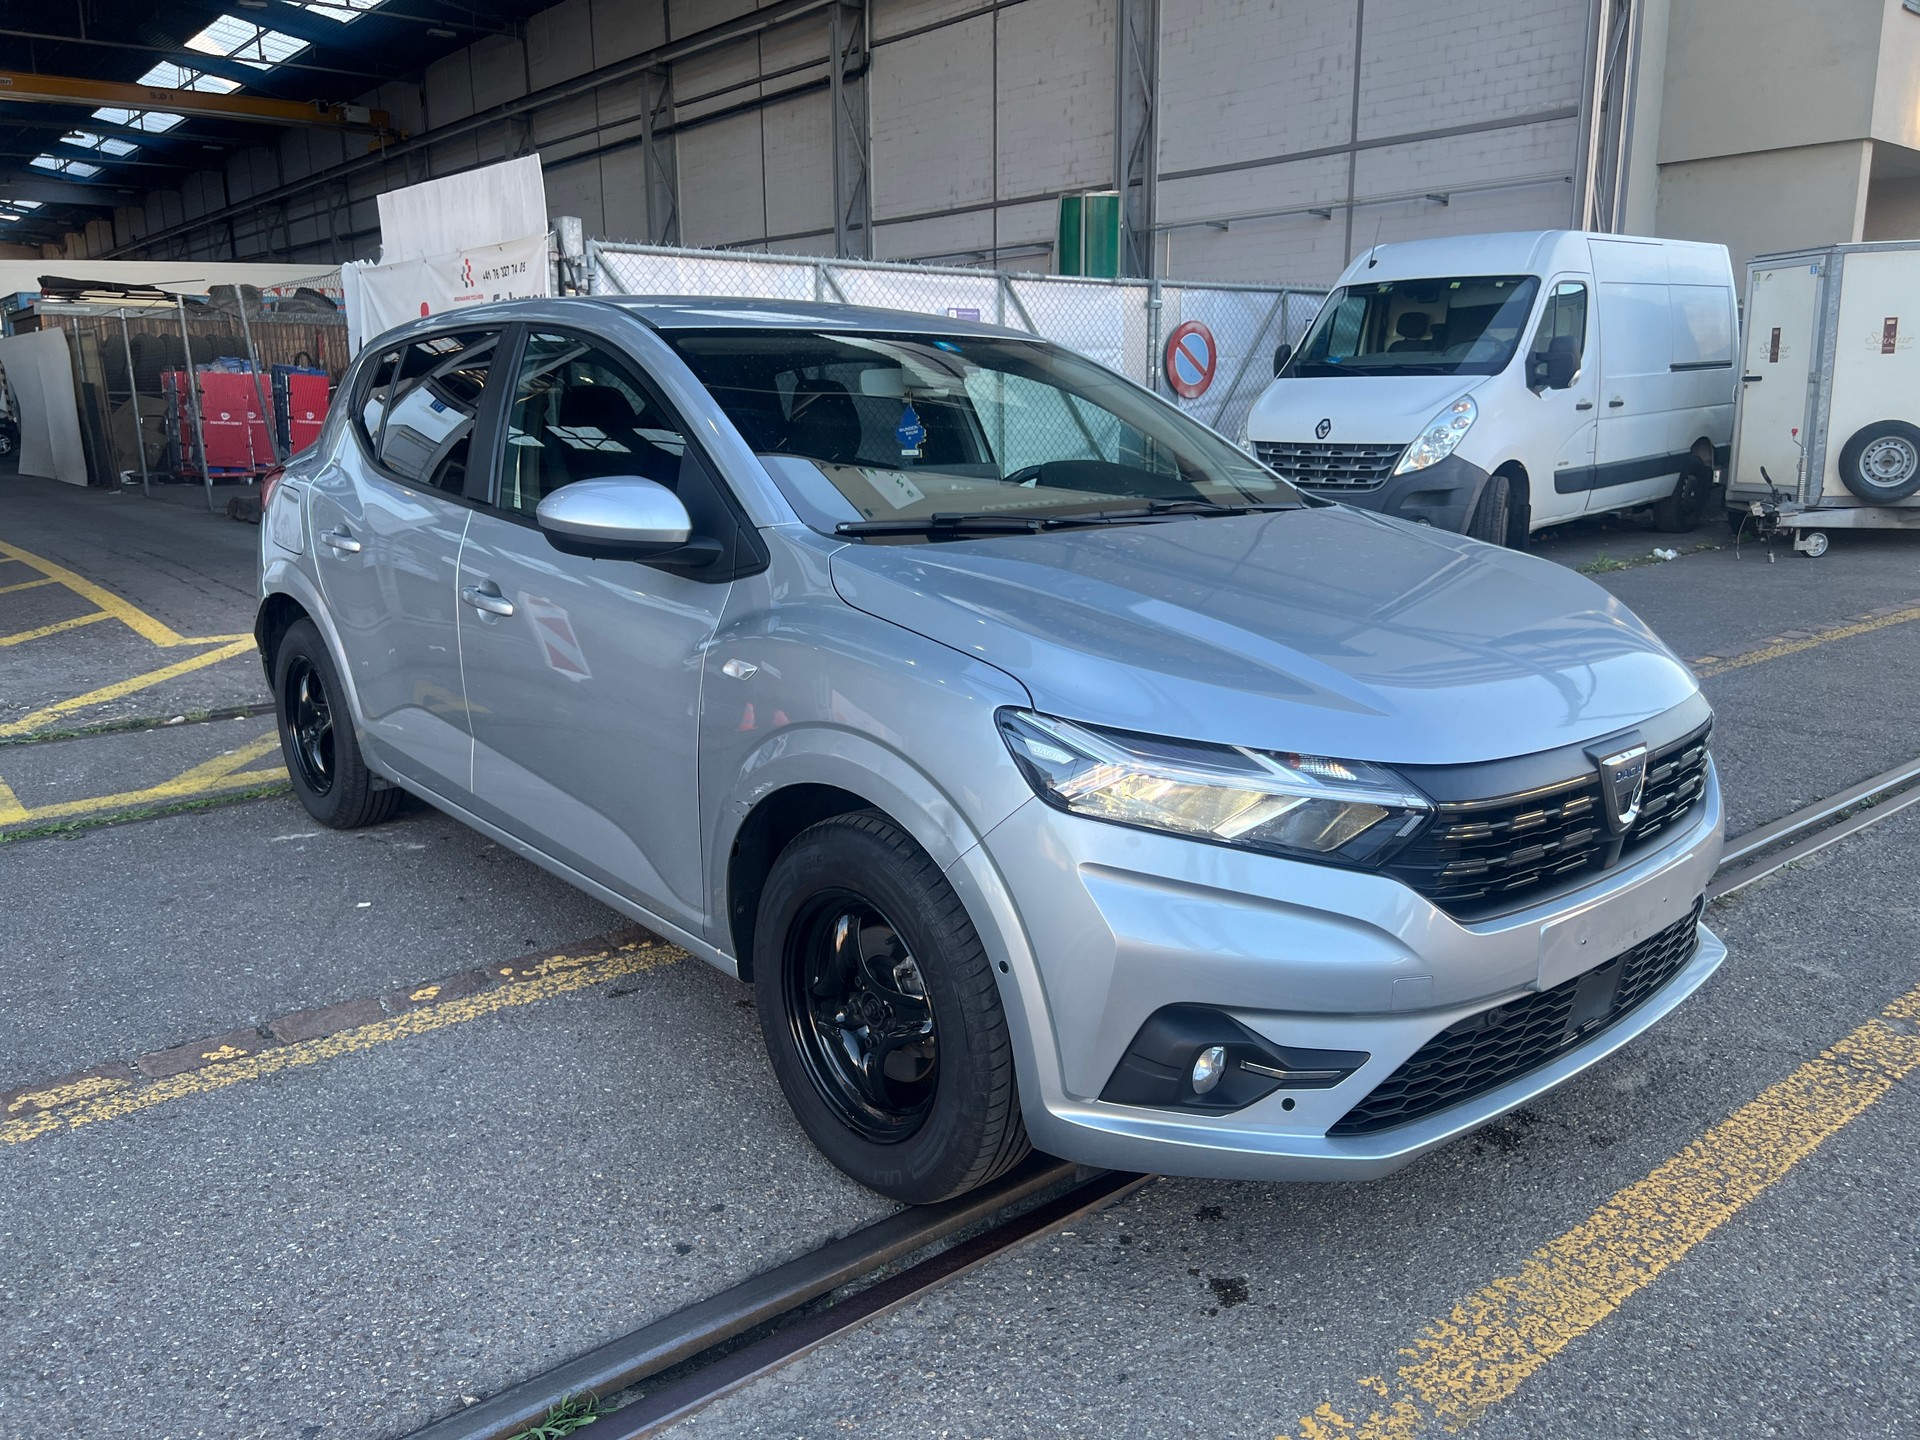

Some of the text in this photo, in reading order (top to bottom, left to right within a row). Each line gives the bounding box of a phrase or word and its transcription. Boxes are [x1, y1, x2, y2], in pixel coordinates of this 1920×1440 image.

[492, 268, 500, 280] 76
[500, 265, 510, 278] 327
[511, 263, 518, 275] 74
[1032, 747, 1062, 761] DACIA
[1615, 763, 1643, 783] DACIA
